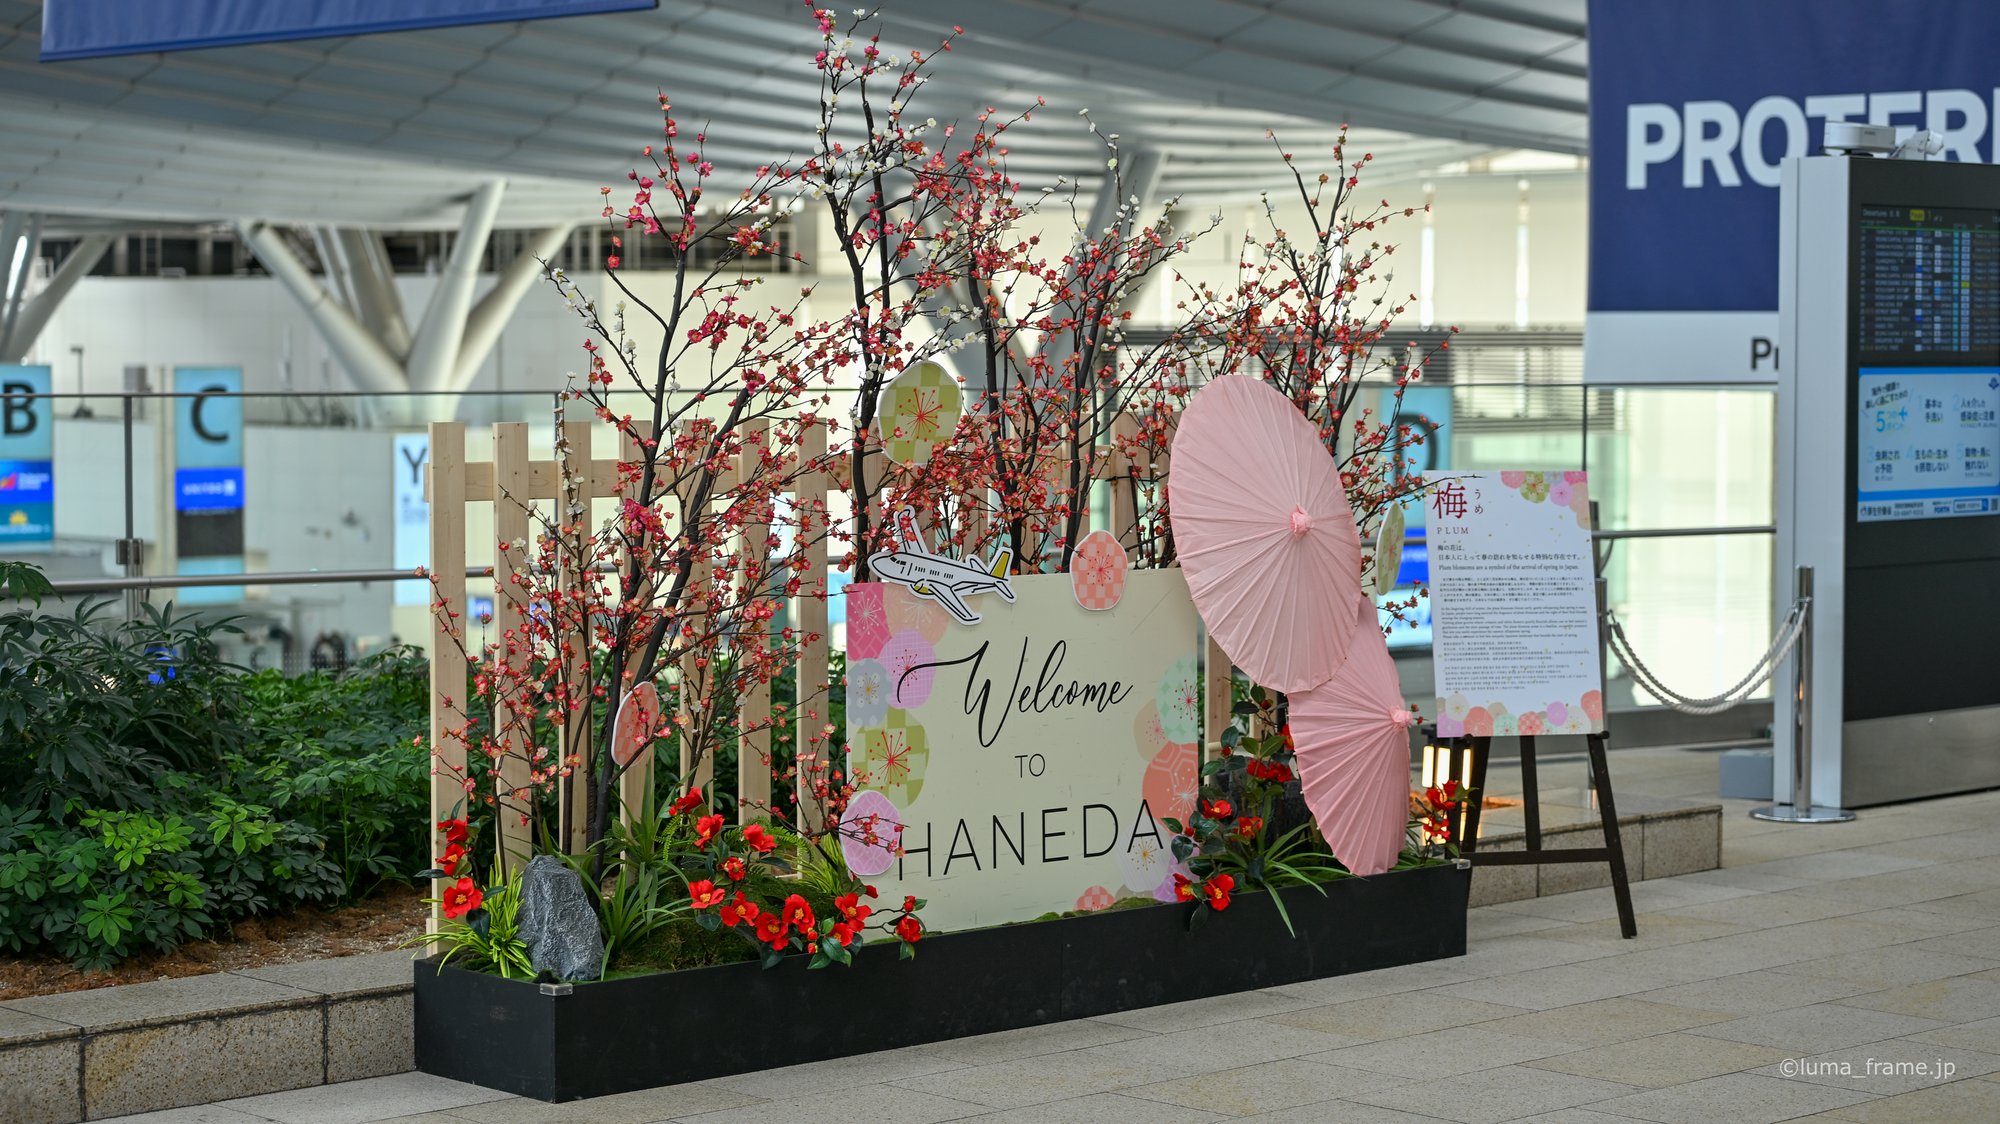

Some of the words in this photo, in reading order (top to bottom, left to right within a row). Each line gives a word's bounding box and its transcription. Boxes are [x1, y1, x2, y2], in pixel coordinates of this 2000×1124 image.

[2, 381, 38, 437] B
[191, 385, 230, 445] C
[1876, 411, 1885, 432] 5
[1432, 482, 1468, 519] 梅
[1474, 489, 1484, 515] うめ
[1437, 527, 1469, 535] PLUM
[897, 636, 1134, 748] Welcome
[1014, 753, 1046, 778] TO
[898, 799, 1164, 881] HANEDA
